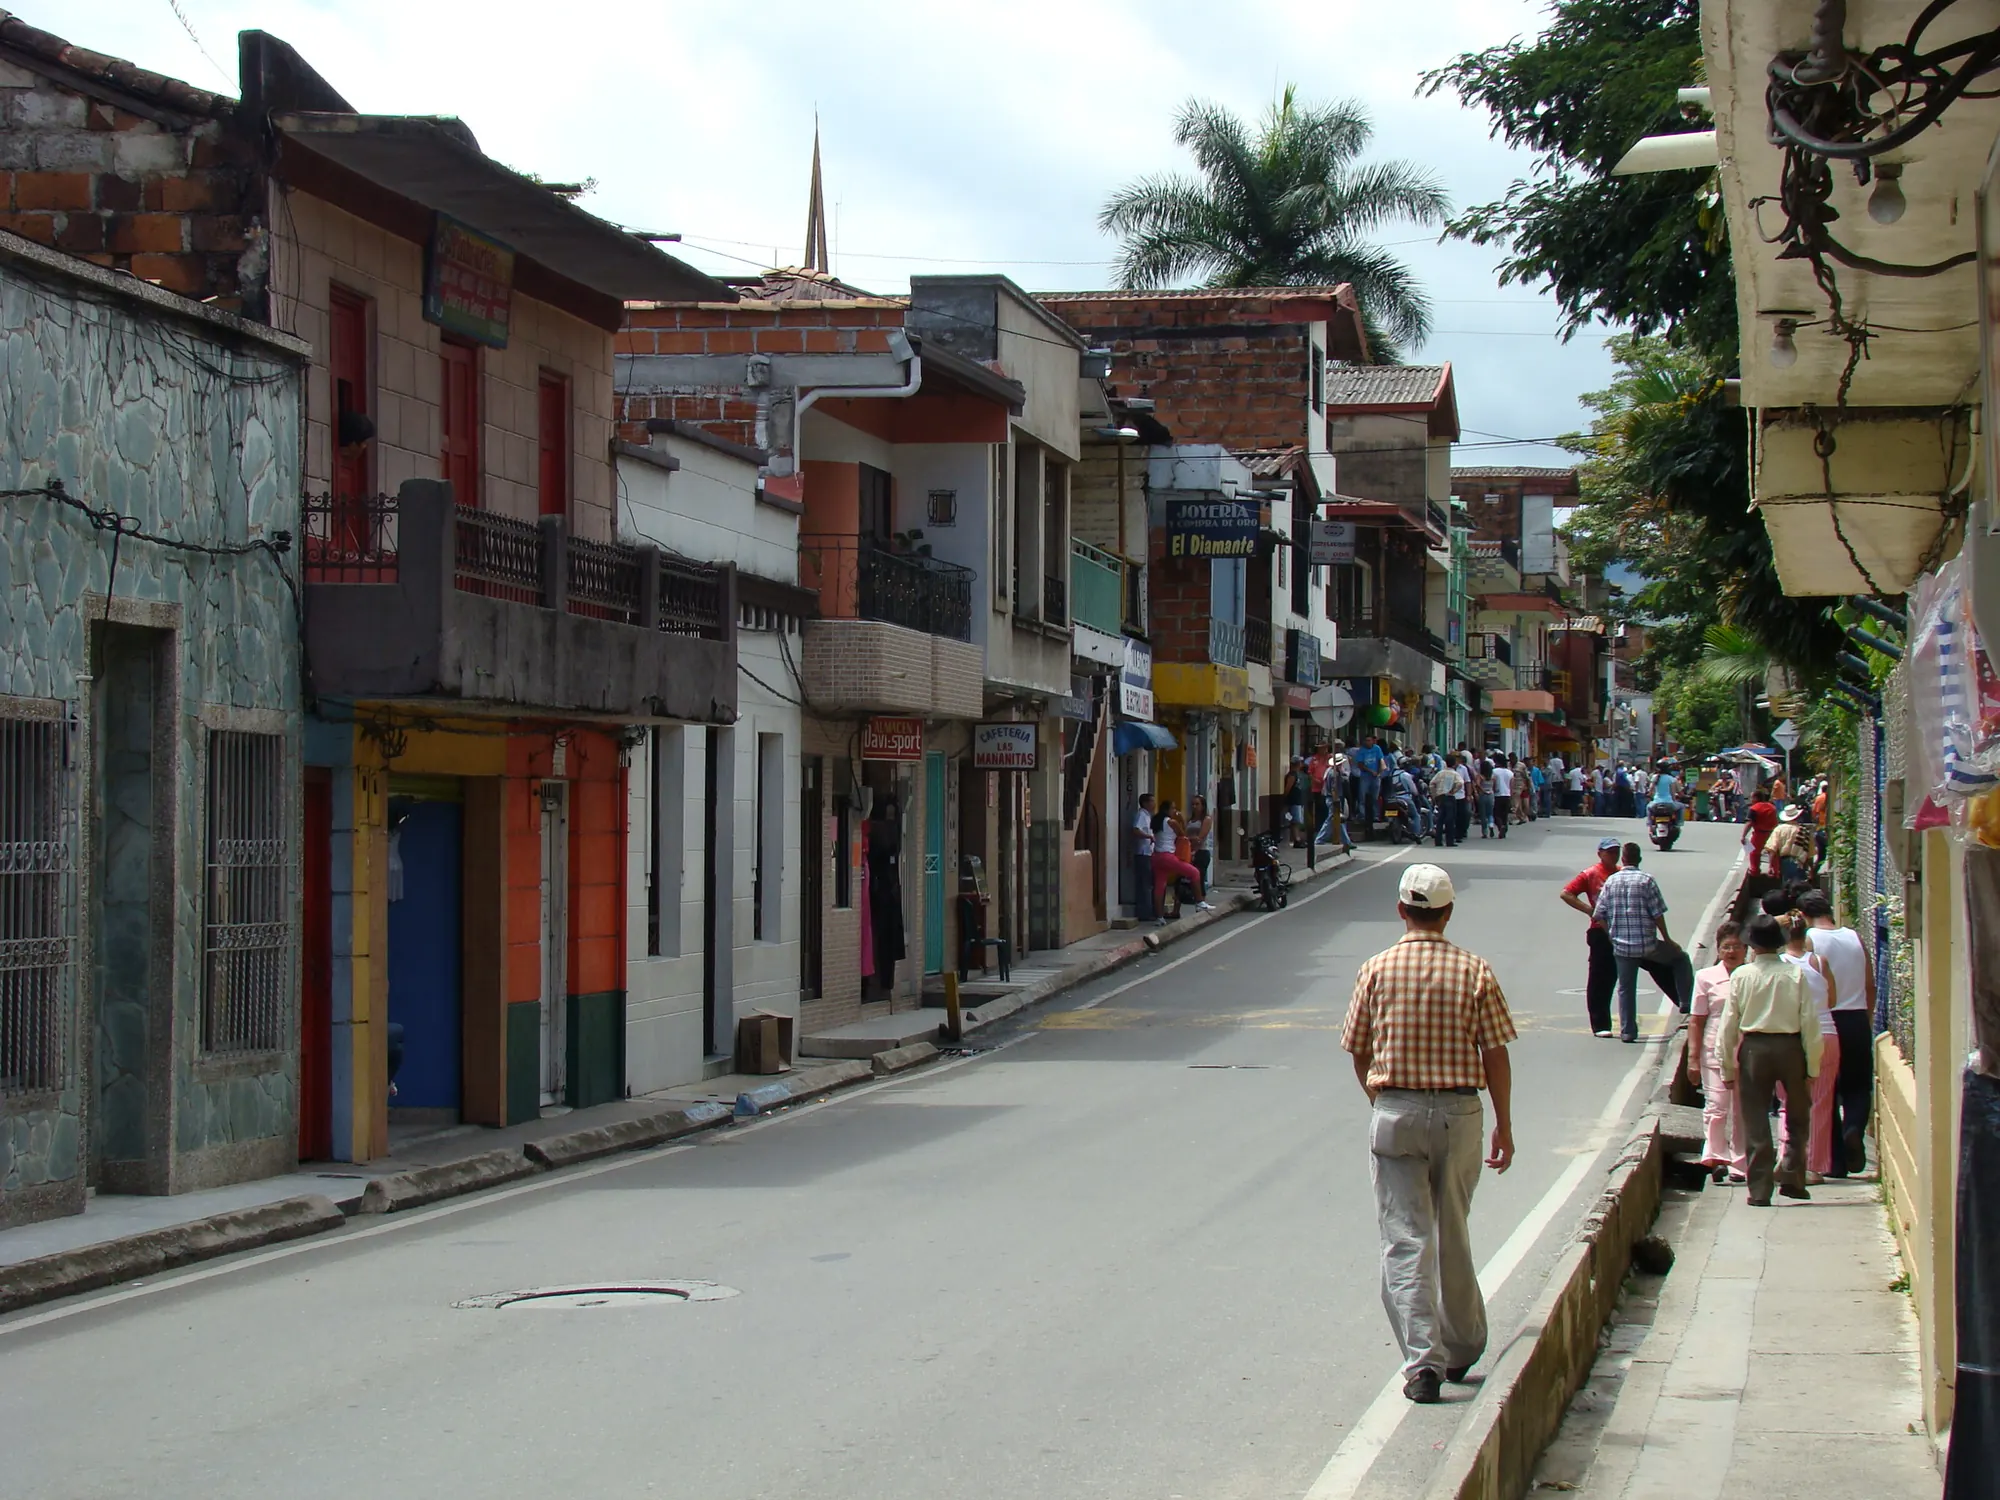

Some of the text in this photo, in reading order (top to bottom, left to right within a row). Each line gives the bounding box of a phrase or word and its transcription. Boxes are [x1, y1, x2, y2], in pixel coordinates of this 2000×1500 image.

[1177, 519, 1219, 528] COMPRA
[1236, 518, 1258, 527] ORO
[1172, 533, 1254, 556] El Diamante
[980, 727, 1031, 743] CAFETERIA
[997, 742, 1013, 752] LAS
